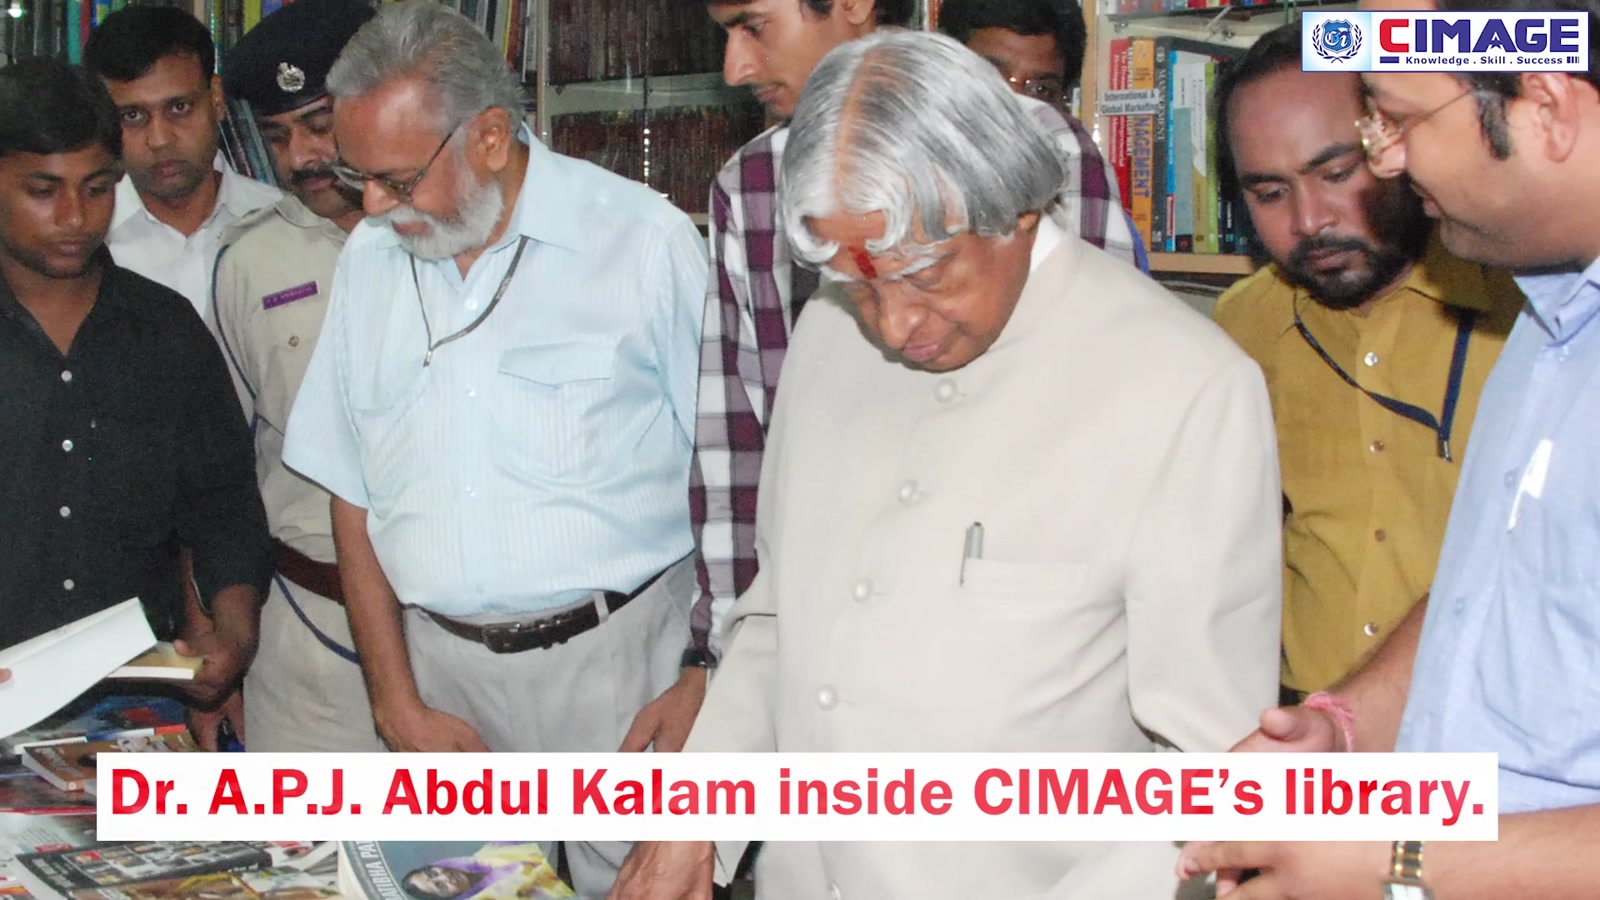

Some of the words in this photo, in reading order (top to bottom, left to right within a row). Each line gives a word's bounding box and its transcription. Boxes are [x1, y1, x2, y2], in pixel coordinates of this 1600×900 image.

[1101, 103, 1123, 114] Global
[1125, 102, 1159, 113] Marketing
[1104, 91, 1148, 101] International
[1135, 117, 1150, 198] NAGEMENT
[365, 861, 401, 900] ATIBHA
